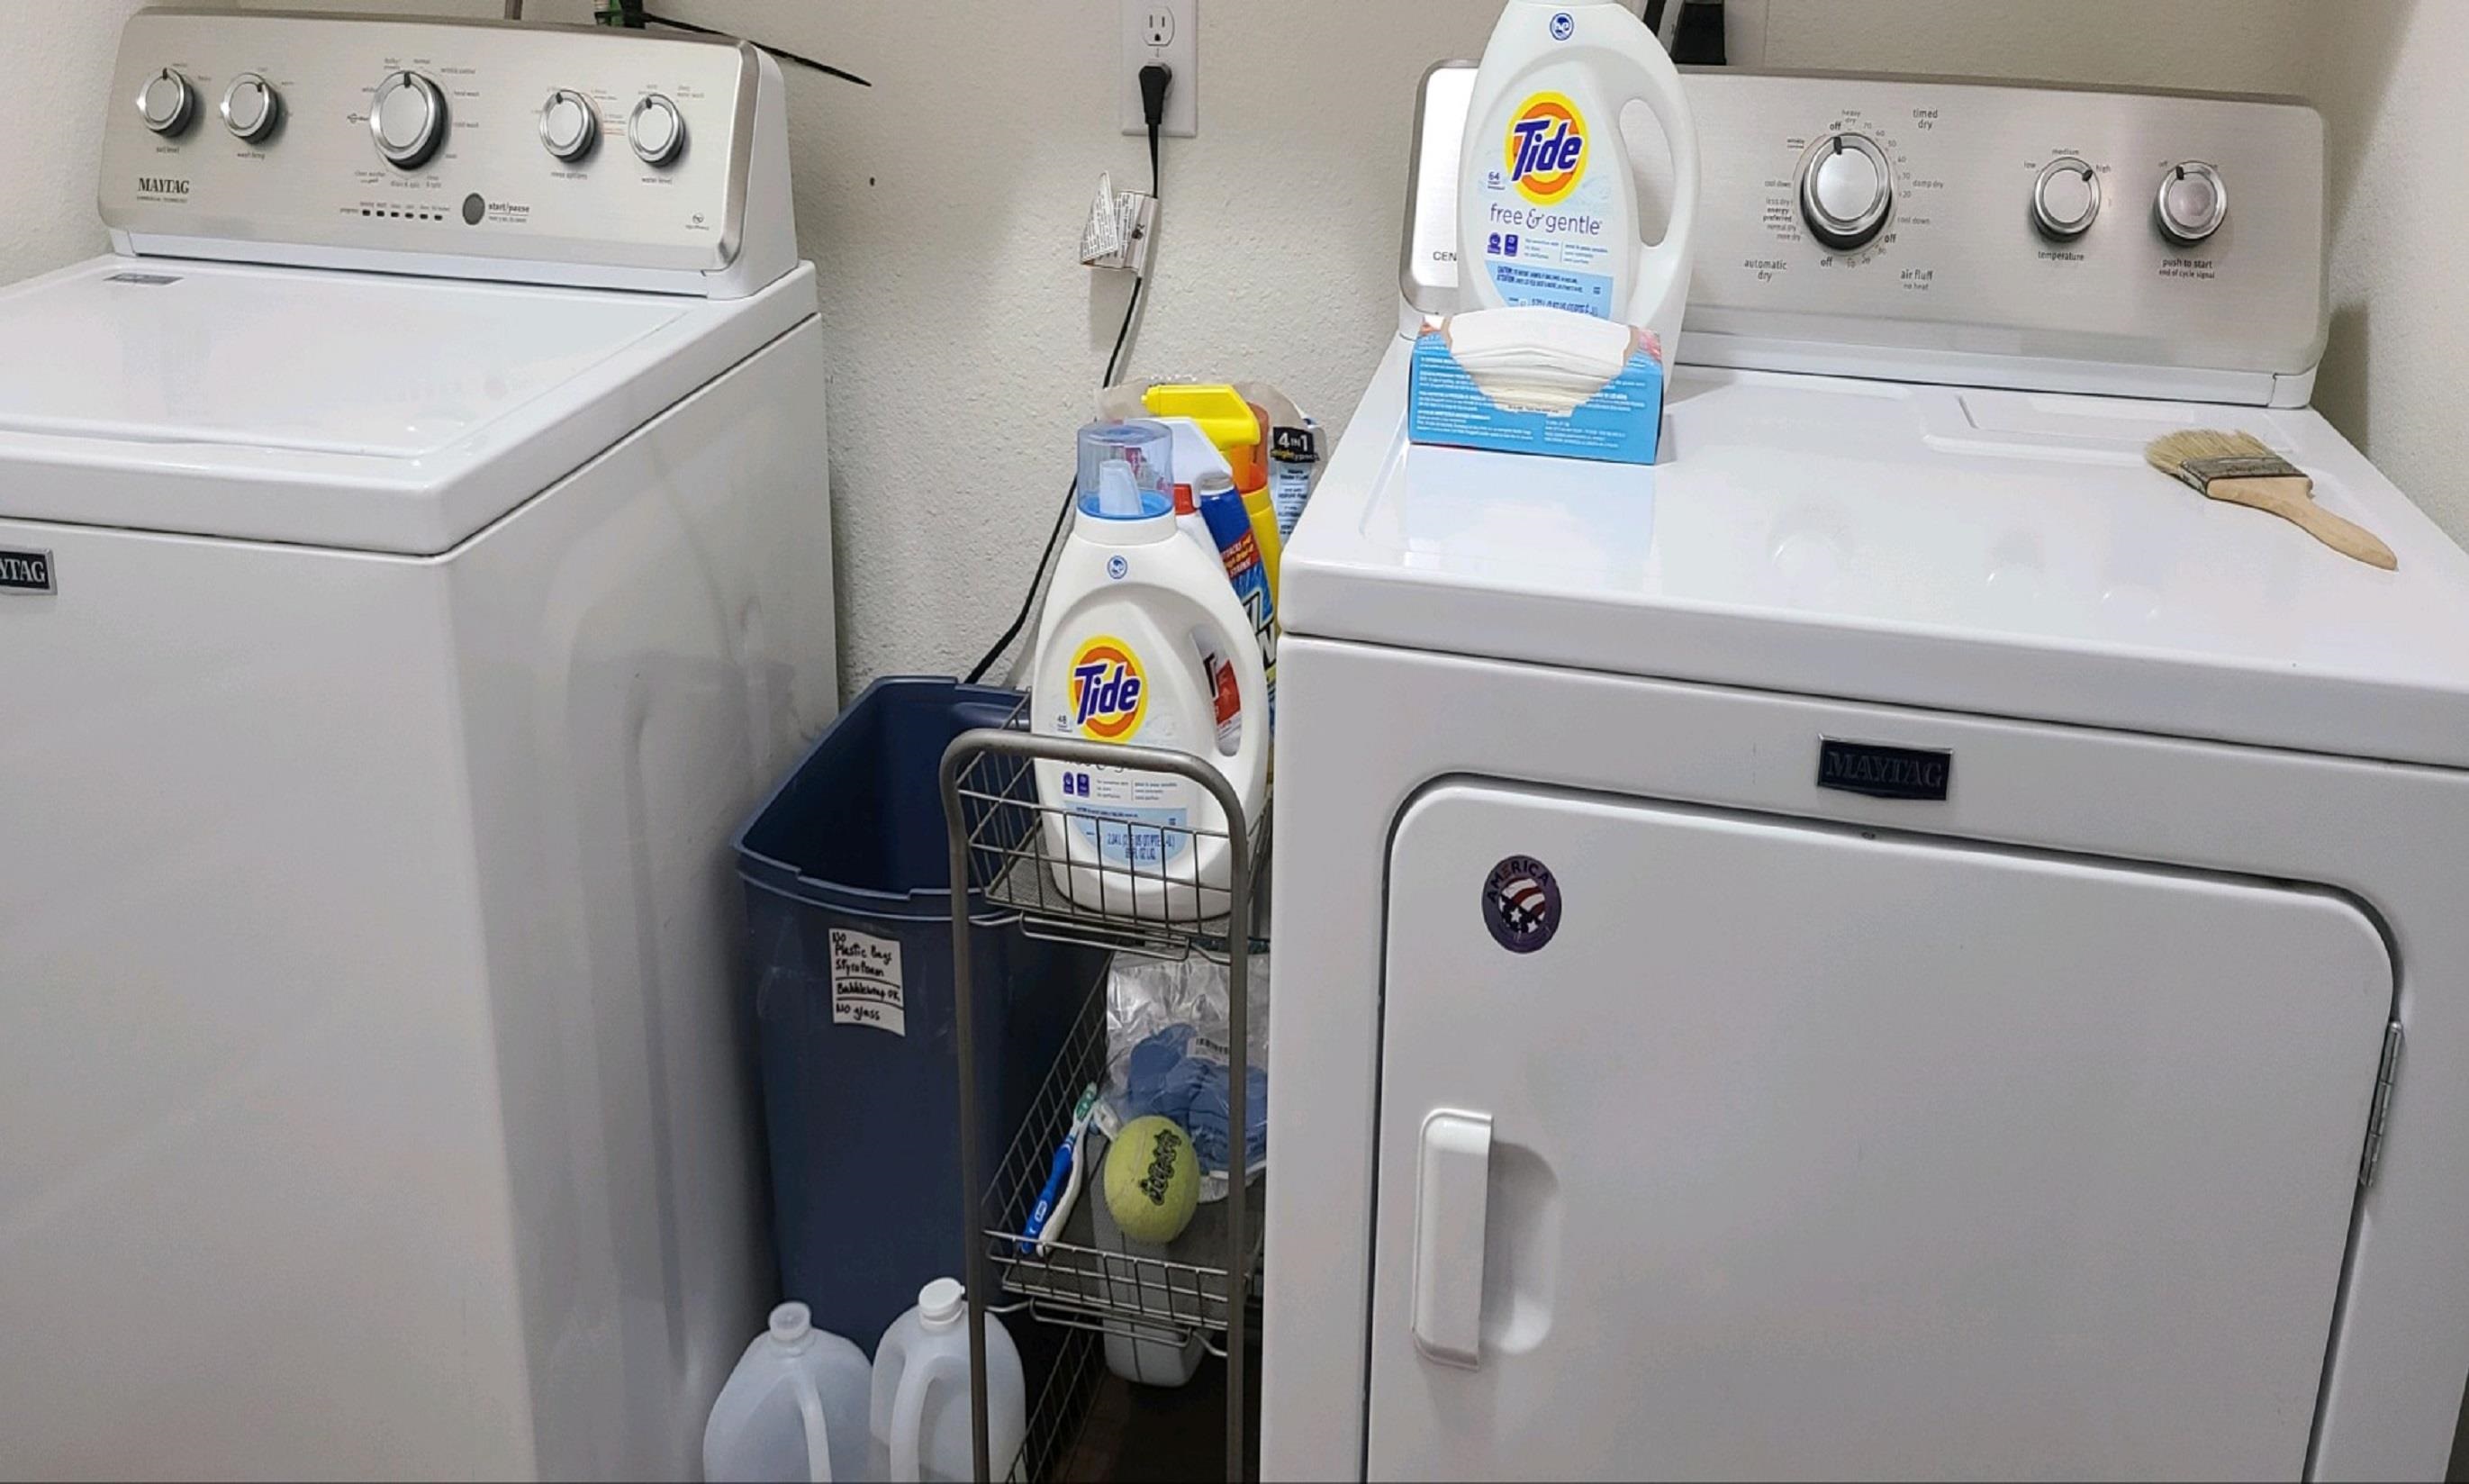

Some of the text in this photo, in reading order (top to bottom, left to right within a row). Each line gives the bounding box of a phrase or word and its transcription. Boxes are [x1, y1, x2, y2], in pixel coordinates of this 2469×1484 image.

[1913, 108, 1938, 119] timed
[1829, 122, 1841, 131] off
[1917, 119, 1933, 131] dry
[1511, 119, 1583, 182] Tide
[2051, 147, 2079, 156] medium
[2023, 160, 2036, 169] low
[2095, 163, 2111, 174] high
[138, 177, 190, 195] MAYTAG
[1767, 207, 1789, 216] energy
[1490, 203, 1601, 236] free & gentle
[1763, 214, 1792, 223] preferred
[1885, 233, 1896, 243] off
[2038, 250, 2085, 262] temperature
[1744, 258, 1787, 270] automatic
[1821, 257, 1832, 267] off
[2163, 258, 2212, 269] push to start
[1758, 270, 1772, 282] dry
[1900, 269, 1933, 280] air fluff
[2170, 269, 2179, 277] of
[2179, 270, 2195, 278] cycle
[2196, 271, 2215, 280] signal
[1278, 432, 1289, 448] 4
[1300, 434, 1308, 451] 1
[1073, 662, 1141, 725] Tide
[1825, 750, 1942, 788] MAYTAG
[1488, 860, 1550, 903] AMERICA
